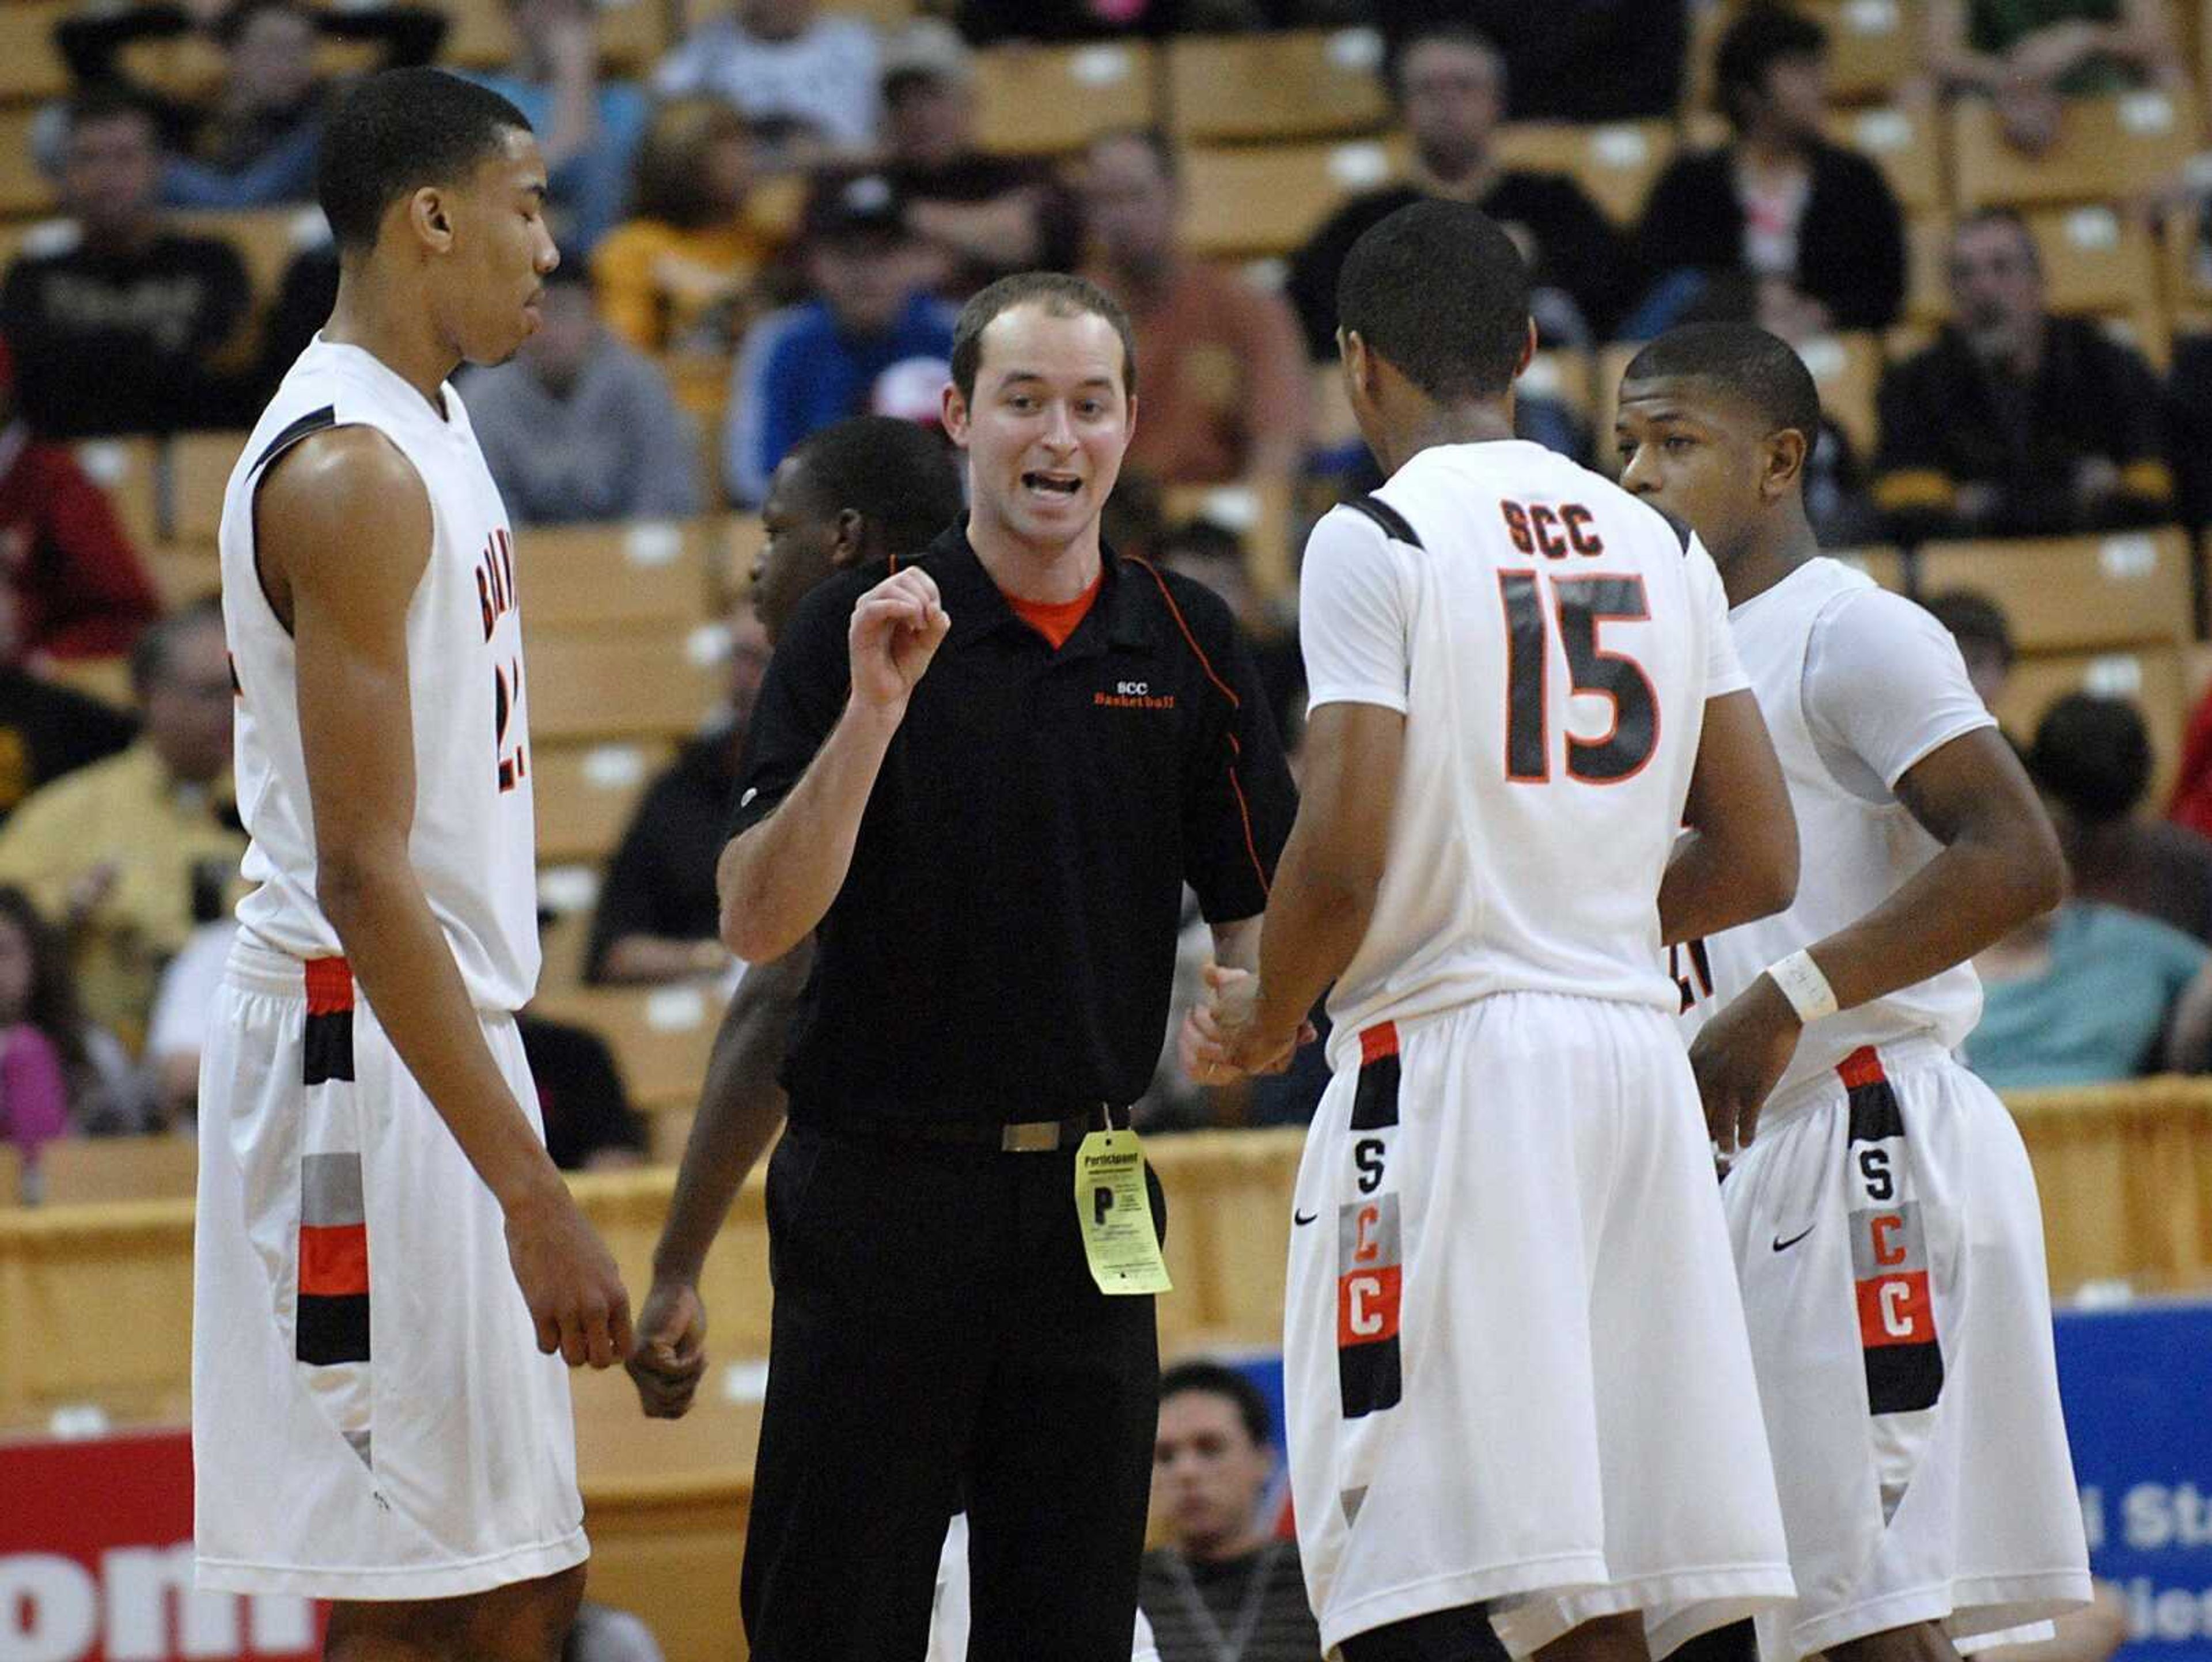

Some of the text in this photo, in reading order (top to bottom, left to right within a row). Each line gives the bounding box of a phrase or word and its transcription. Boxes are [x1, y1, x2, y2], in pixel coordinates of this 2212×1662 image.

[1501, 499, 1604, 559] SCC
[1117, 681, 1149, 695] SCC
[1498, 568, 1662, 786] 15
[1094, 691, 1176, 709] Basketball
[1094, 1187, 1114, 1225] P
